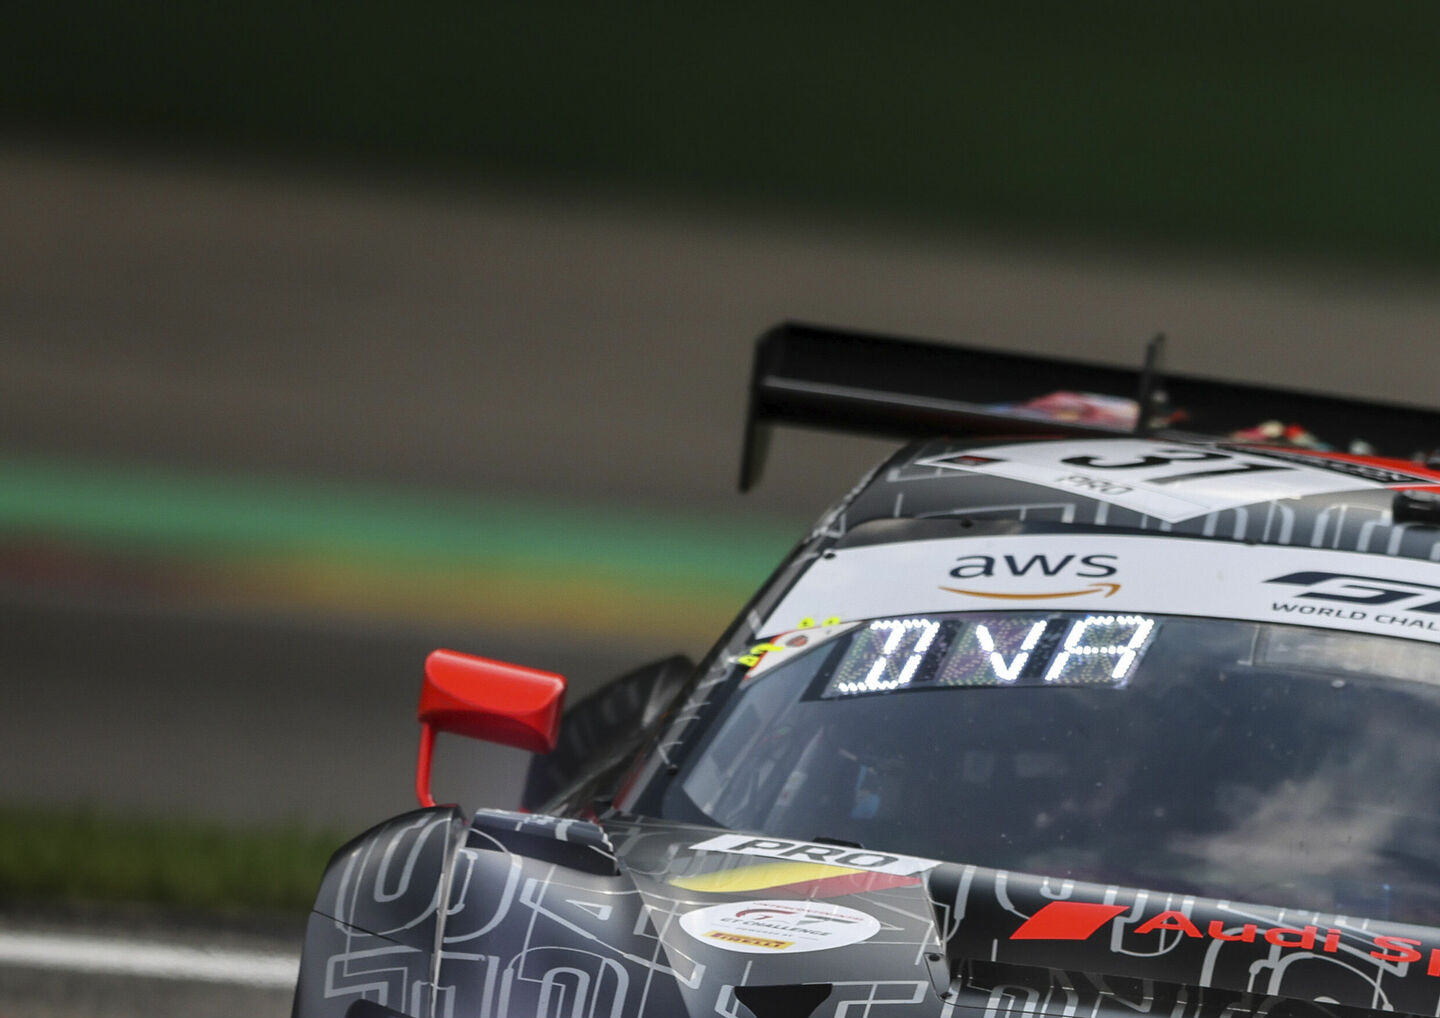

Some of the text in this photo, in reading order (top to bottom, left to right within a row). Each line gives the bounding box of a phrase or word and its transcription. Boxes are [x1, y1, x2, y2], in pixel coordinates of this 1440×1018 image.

[1056, 474, 1134, 495] PRO
[948, 552, 1120, 580] aws
[1271, 602, 1367, 620] WORLD
[730, 838, 900, 868] PRO
[742, 920, 833, 937] CHALLENGE
[1134, 909, 1342, 953] Audi
